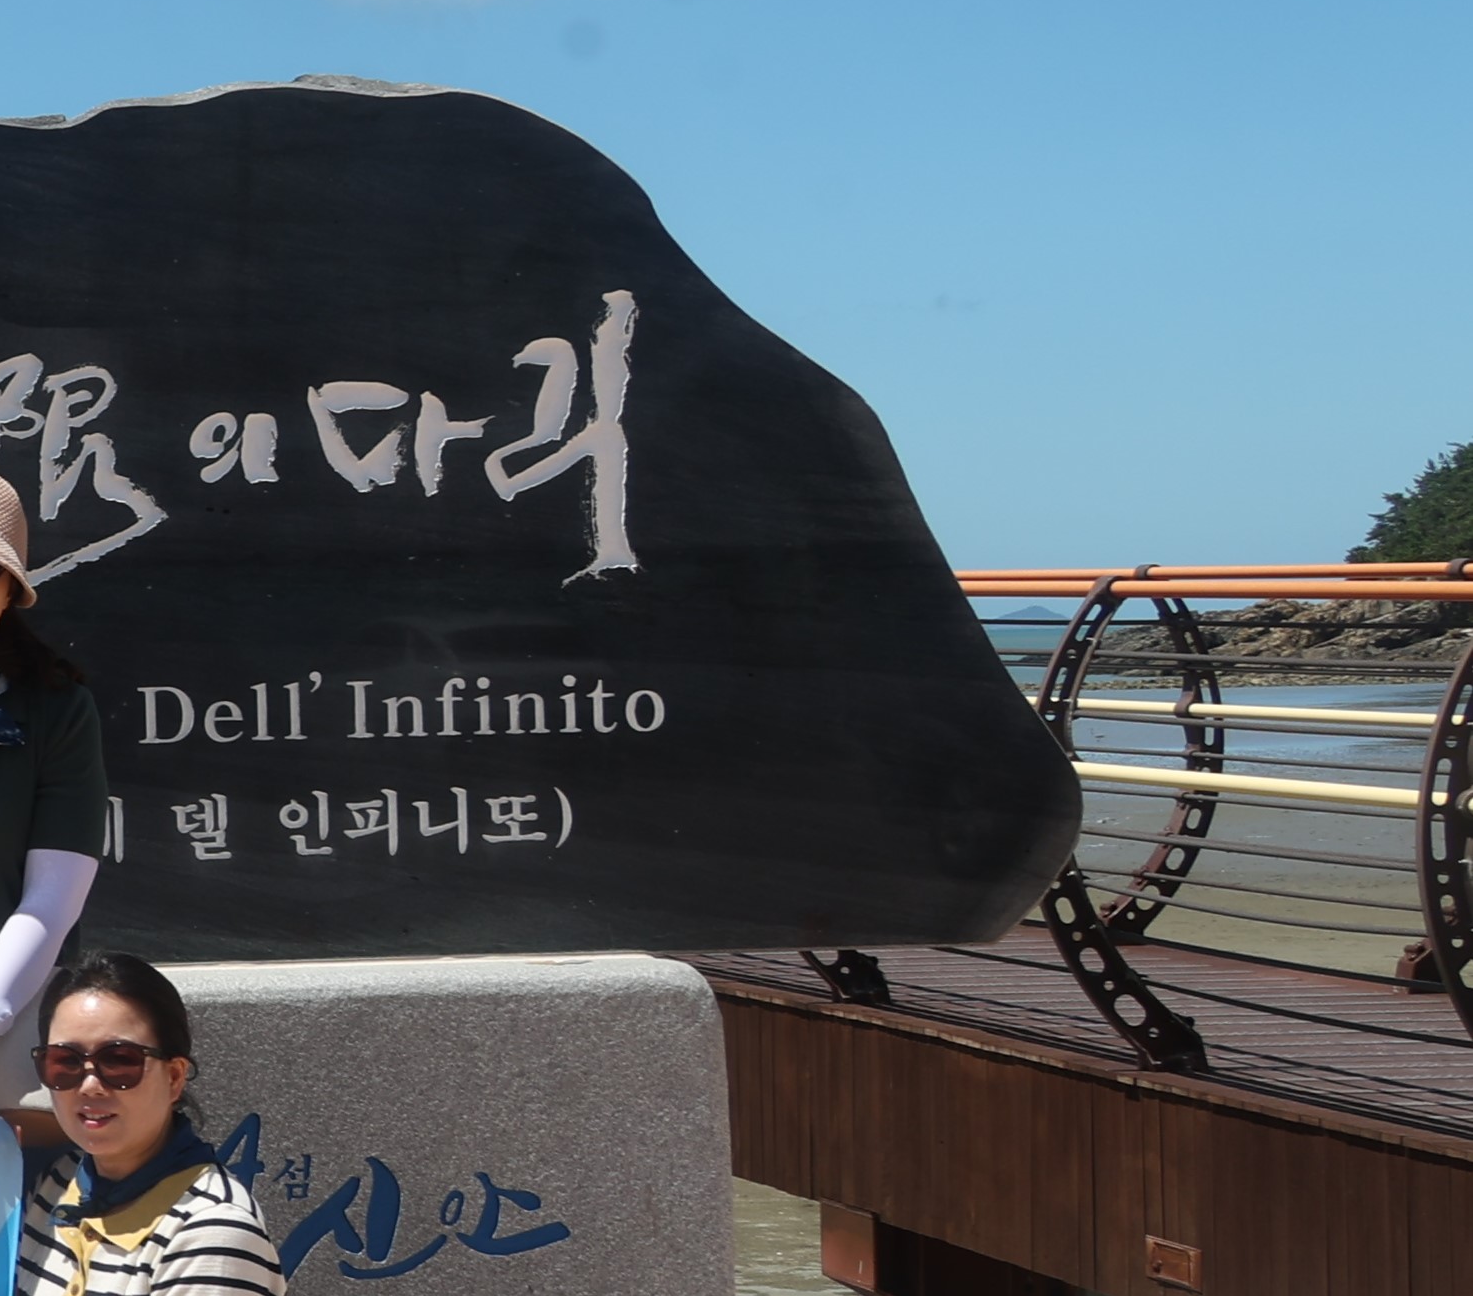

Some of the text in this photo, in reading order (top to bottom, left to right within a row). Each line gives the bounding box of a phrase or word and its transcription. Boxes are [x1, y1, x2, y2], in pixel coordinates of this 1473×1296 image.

[306, 289, 640, 587] 다리
[345, 673, 667, 739] Infinito
[170, 793, 233, 861] 델
[278, 786, 574, 857] 인피니또)
